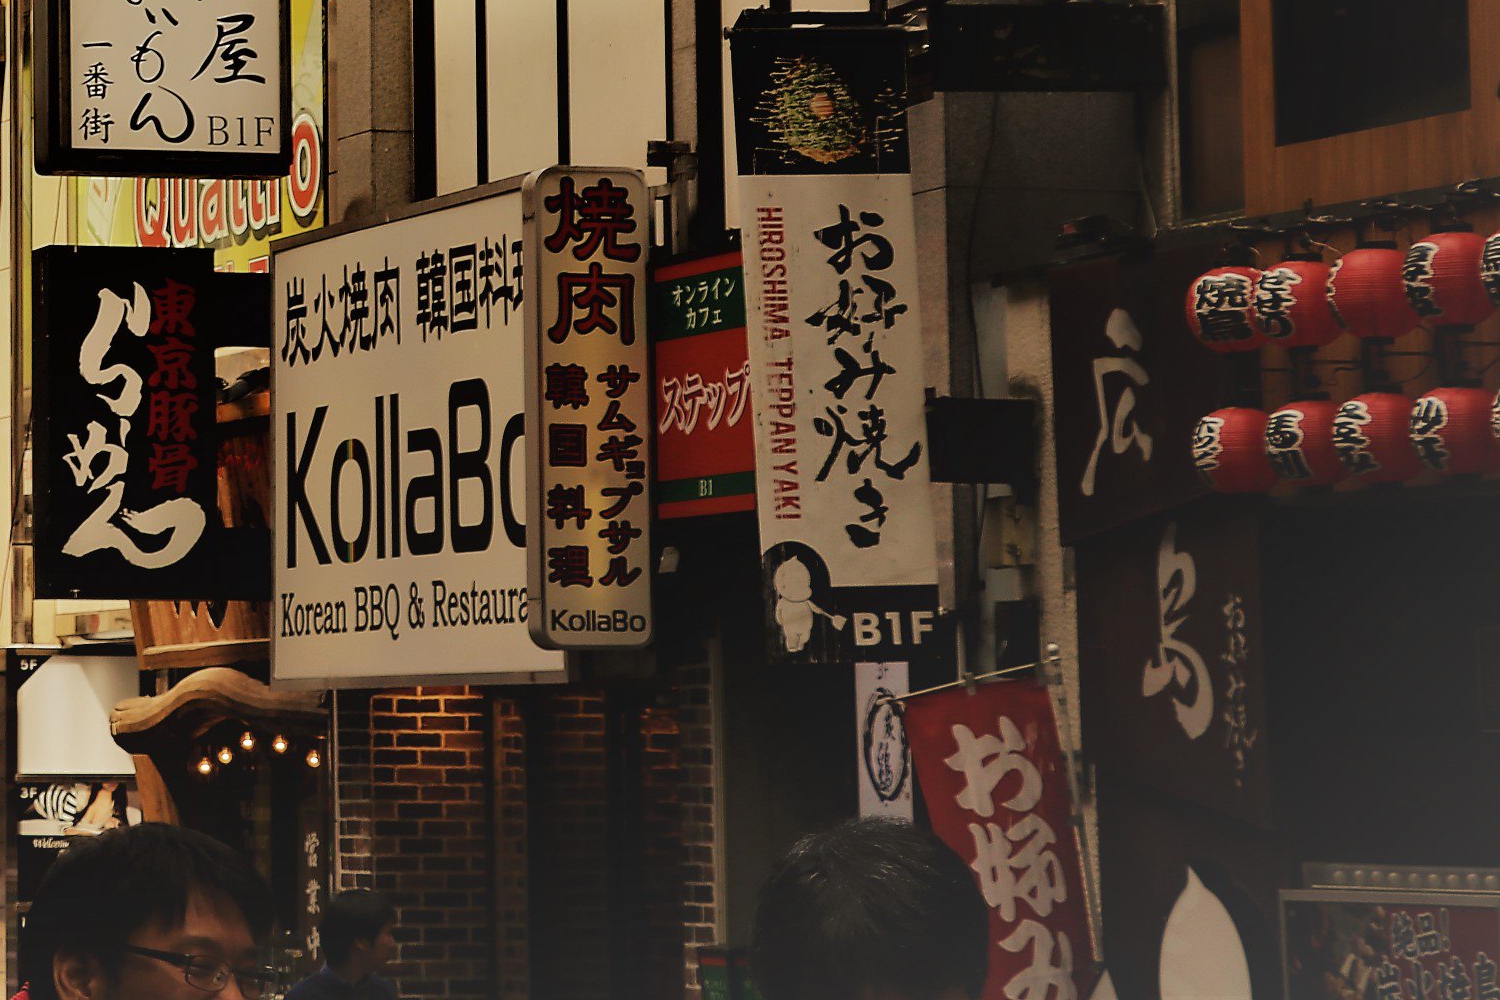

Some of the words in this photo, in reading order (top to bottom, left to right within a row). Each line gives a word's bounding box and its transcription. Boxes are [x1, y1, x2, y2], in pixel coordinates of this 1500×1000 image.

[79, 42, 115, 145] 一番街
[206, 114, 276, 149] B1F
[544, 176, 644, 347] 焼肉
[670, 275, 736, 306] オンライン
[756, 205, 793, 343] HIROSHIMA
[281, 256, 402, 368] 炭火焼肉
[685, 307, 723, 330] カフェ
[145, 277, 198, 493] 東京豚骨
[659, 360, 751, 438] ステップ
[803, 202, 923, 549] お好み焼き
[544, 362, 594, 589] 韓国料理
[596, 363, 645, 589] サムギョプサル
[699, 479, 714, 498] B1
[281, 590, 348, 638] Korean
[353, 583, 402, 642] BBQ
[408, 581, 426, 629] &
[551, 609, 647, 634] KollaBo
[852, 611, 935, 647] B1F
